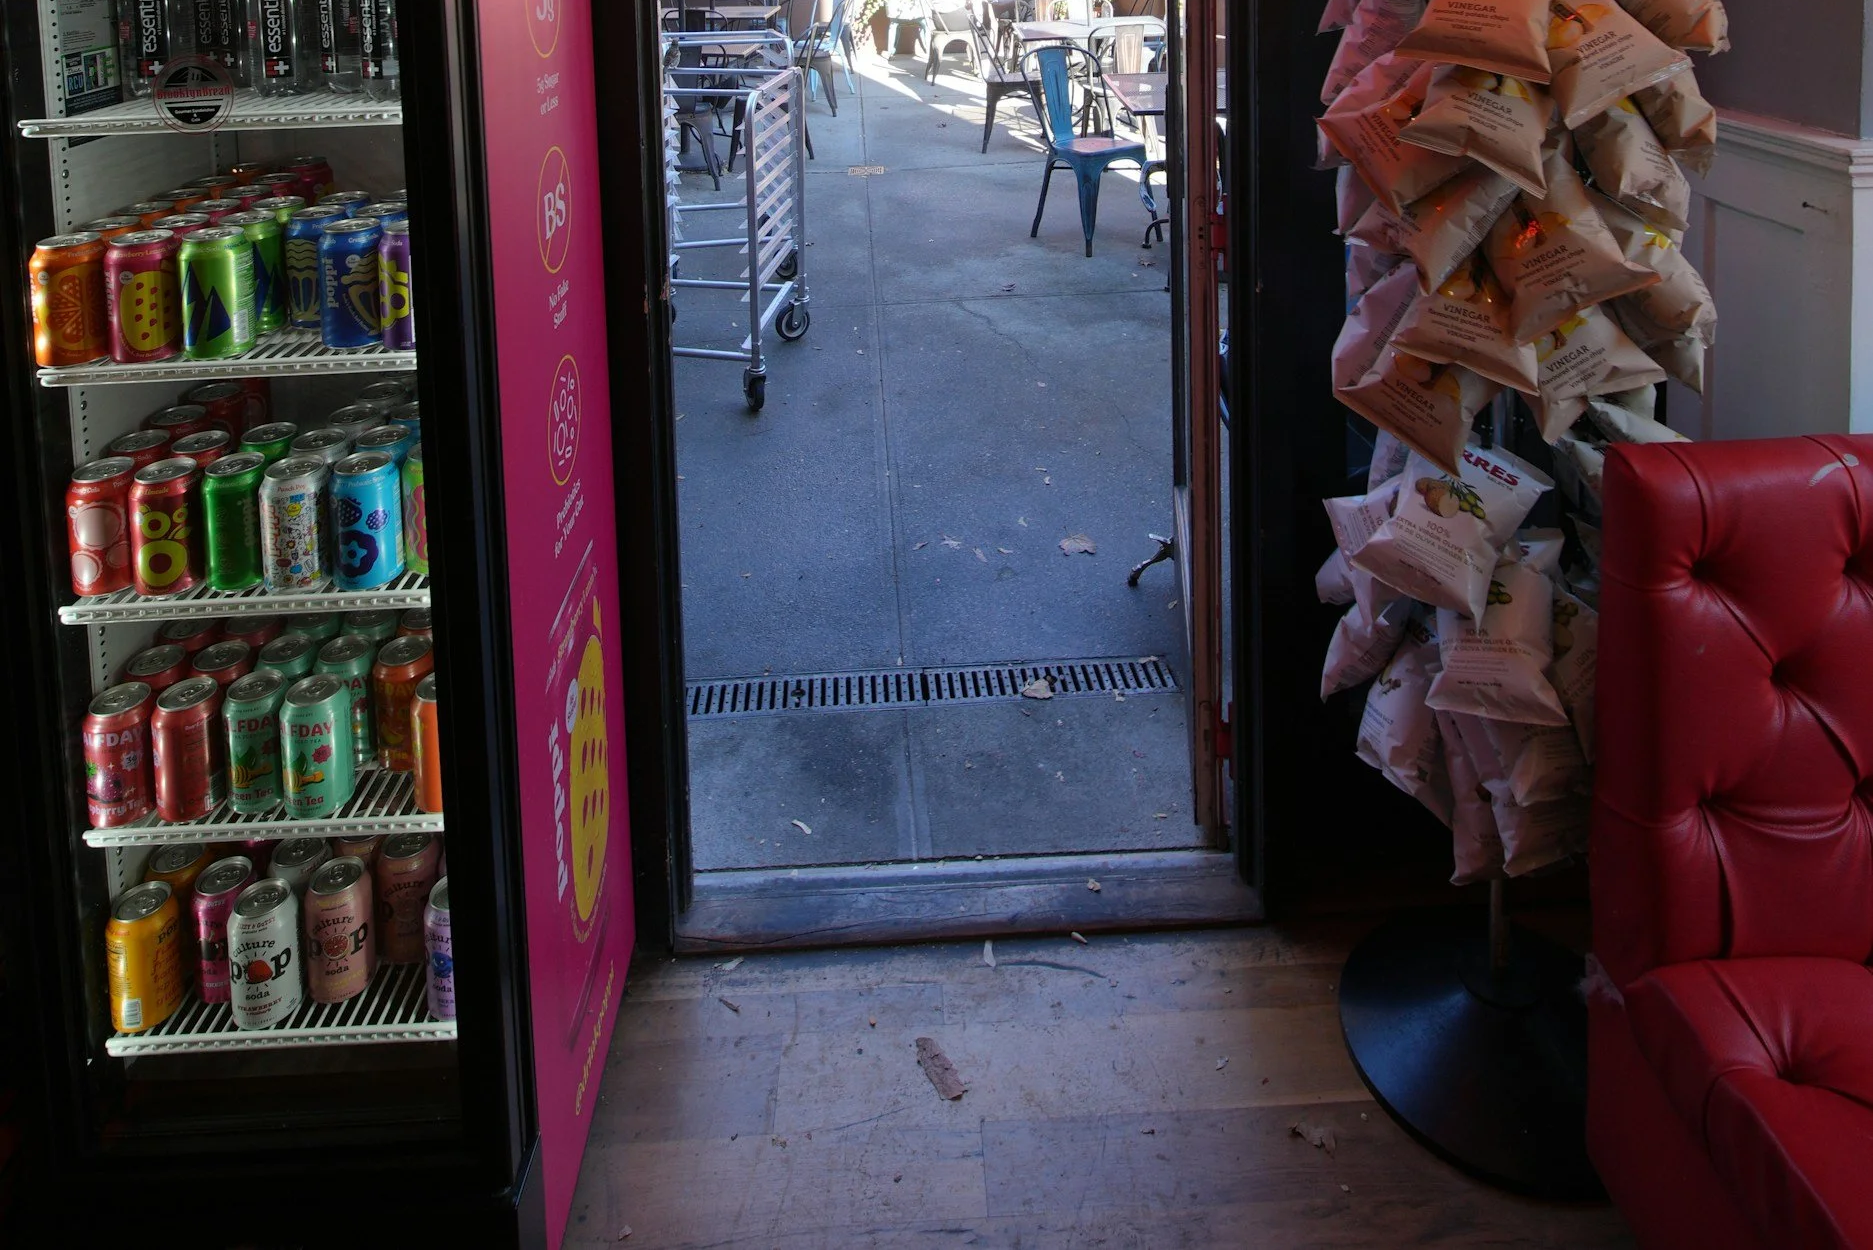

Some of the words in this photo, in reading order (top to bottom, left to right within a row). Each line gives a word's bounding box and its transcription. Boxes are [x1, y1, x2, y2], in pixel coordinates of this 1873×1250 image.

[1448, 1, 1497, 13] VINEGAR
[1576, 30, 1617, 54] VINEGAR
[1467, 91, 1513, 115] VINEGAR
[1520, 244, 1568, 270] VINEGAR
[321, 257, 339, 309] poppi
[1443, 303, 1490, 323] VINEGAR
[1546, 344, 1590, 373] VINEGAR
[1395, 379, 1435, 412] VINEGAR
[1463, 450, 1520, 486] RRES
[1418, 527, 1442, 542] VIRGIN
[1442, 540, 1464, 553] OLIVE
[1427, 520, 1450, 538] 100%
[1415, 533, 1436, 548] OLIVA
[1437, 545, 1462, 562] VIRGEN
[83, 725, 143, 748] ALFDAY
[255, 788, 274, 799] Tea
[304, 795, 324, 807] Tea
[548, 716, 568, 903] poppi
[312, 915, 355, 935] culture
[233, 939, 276, 958] culture
[325, 965, 350, 976] soda
[245, 990, 271, 1000] soda
